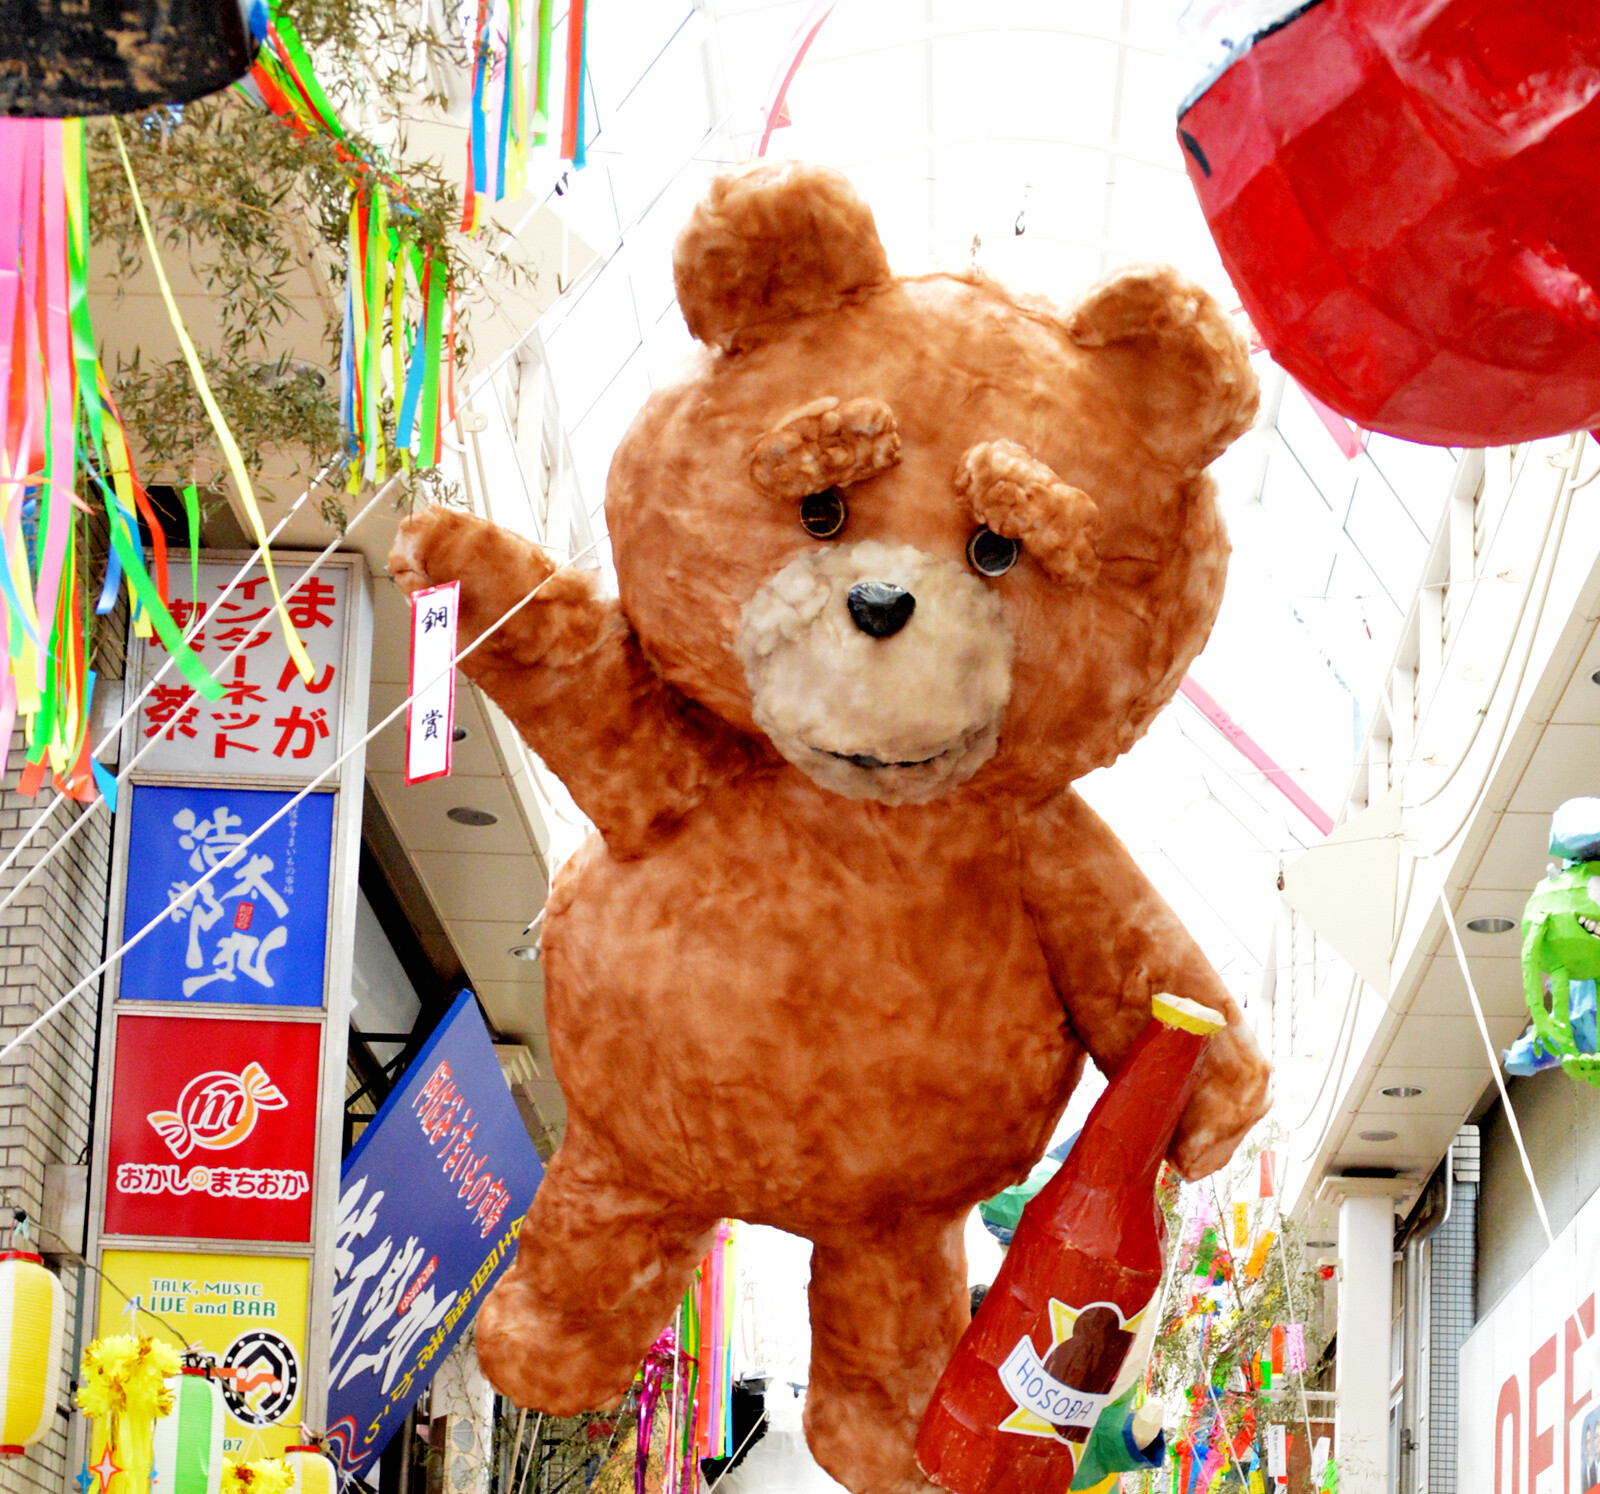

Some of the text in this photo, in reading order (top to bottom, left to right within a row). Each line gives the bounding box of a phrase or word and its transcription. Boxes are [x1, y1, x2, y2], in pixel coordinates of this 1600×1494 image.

[211, 576, 272, 759] インターネット
[273, 577, 336, 759] まんが
[117, 1163, 309, 1200] おかしのまちおか
[136, 1295, 276, 1317] LIVE and BAR
[152, 1279, 263, 1297] TALK, MUSIC
[1016, 1357, 1094, 1420] HOSODA
